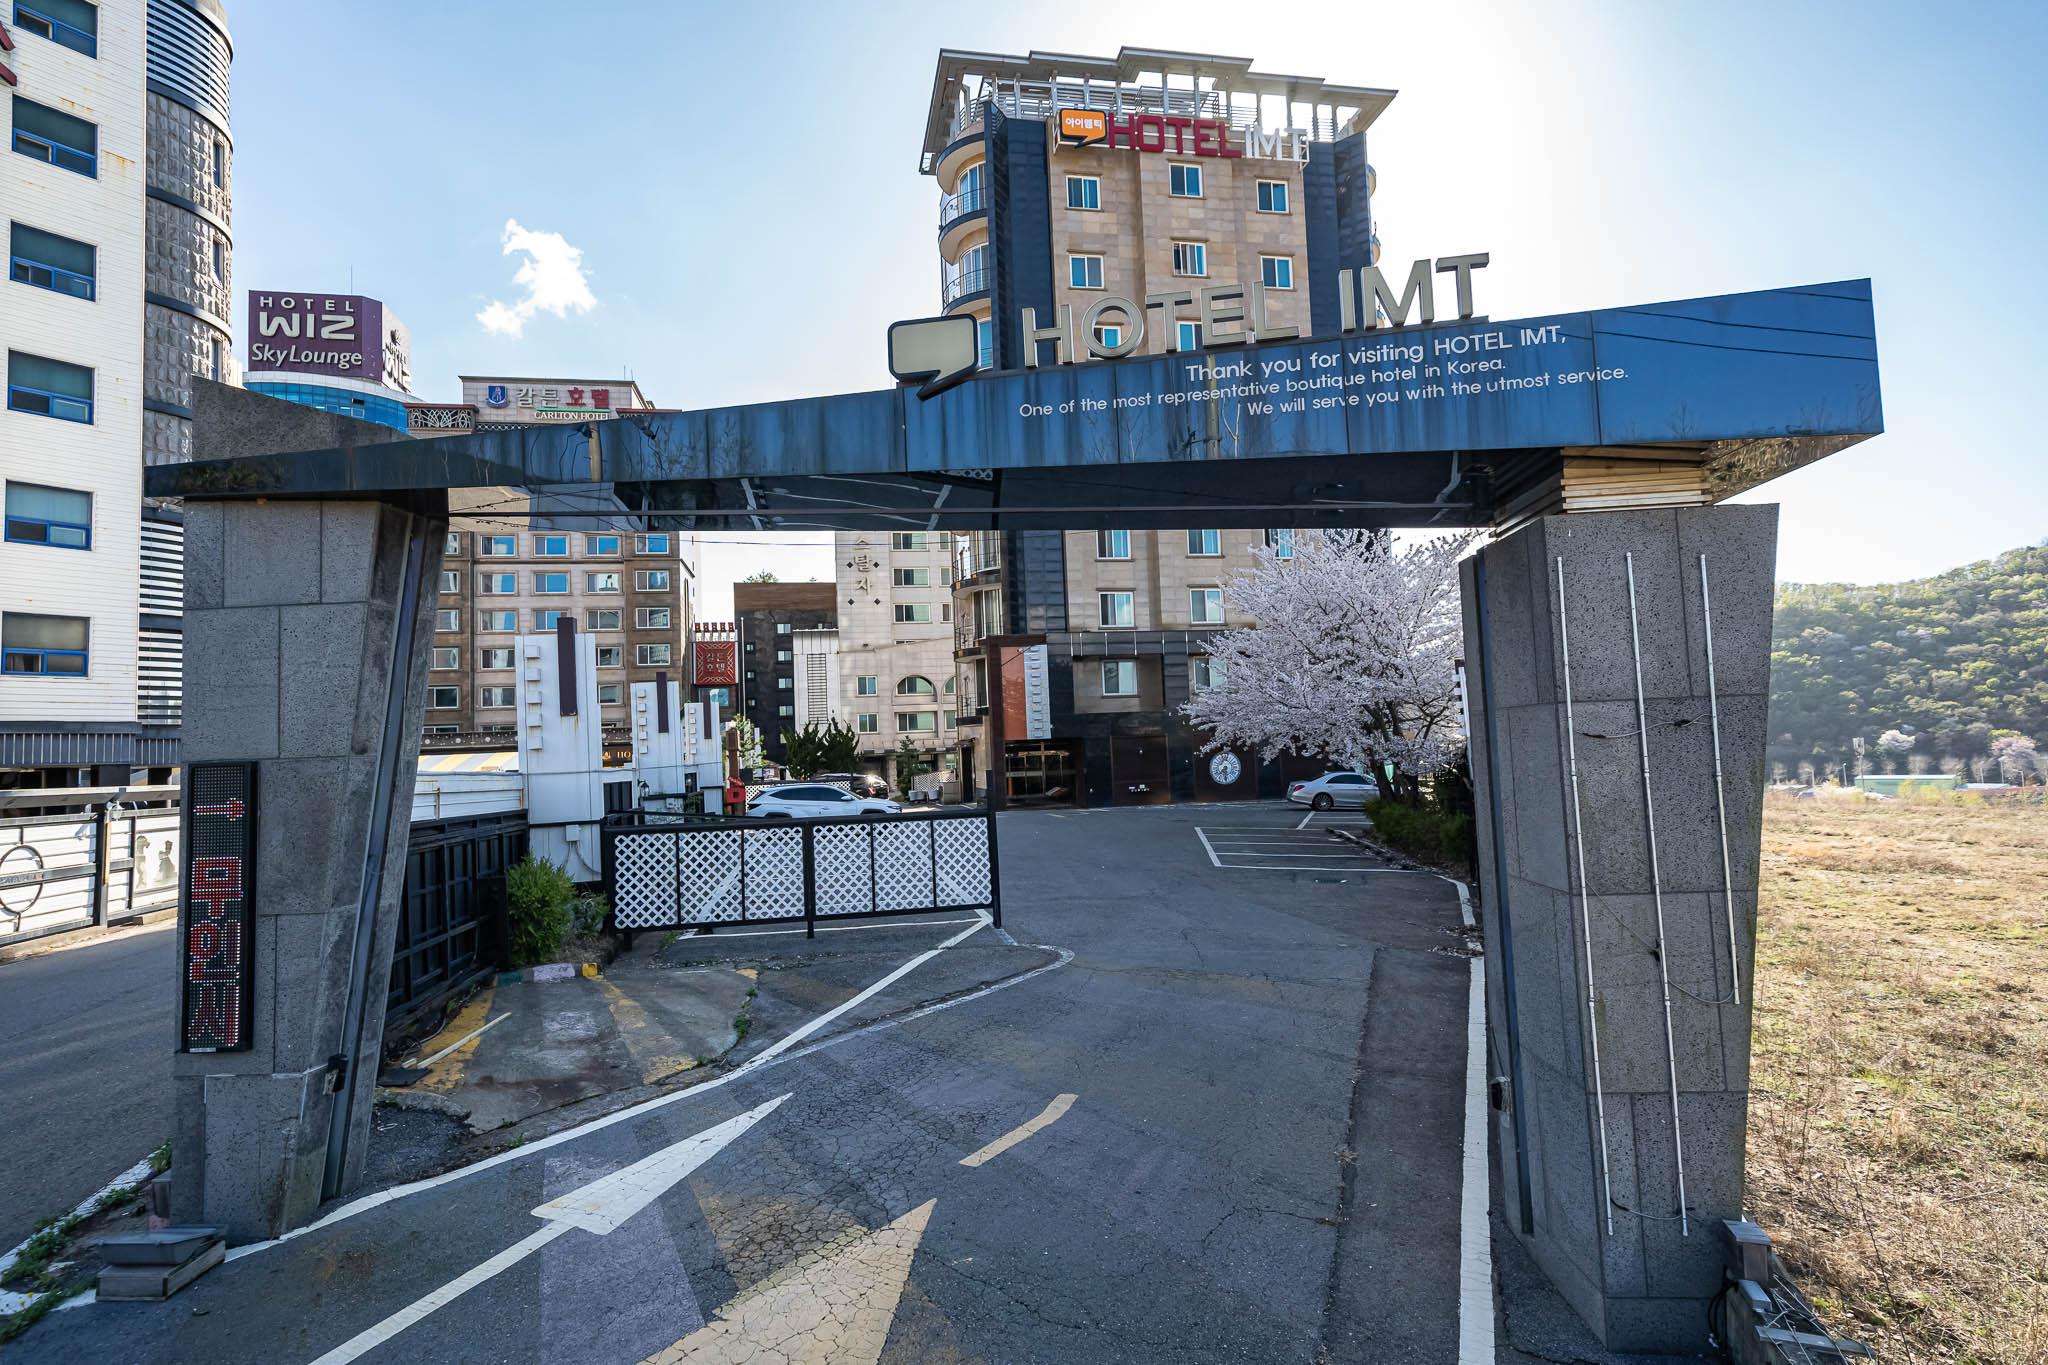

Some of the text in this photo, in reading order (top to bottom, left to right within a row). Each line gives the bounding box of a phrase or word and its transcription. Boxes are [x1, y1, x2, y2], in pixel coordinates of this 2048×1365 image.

[1108, 112, 1307, 161] HOTEL IMT
[259, 311, 355, 340] WIZ
[260, 297, 354, 312] HOTEL
[1022, 252, 1490, 368] HOTEL IMT
[1186, 325, 1567, 382] Thank you for visiting HOTEL IMT,
[565, 387, 609, 408] 호텔
[1019, 358, 1506, 417] One of the most representative boutique hotel in Korea.
[1247, 367, 1628, 416] We will serve you with the utmost service.
[534, 411, 609, 421] CARLTON HOTEL
